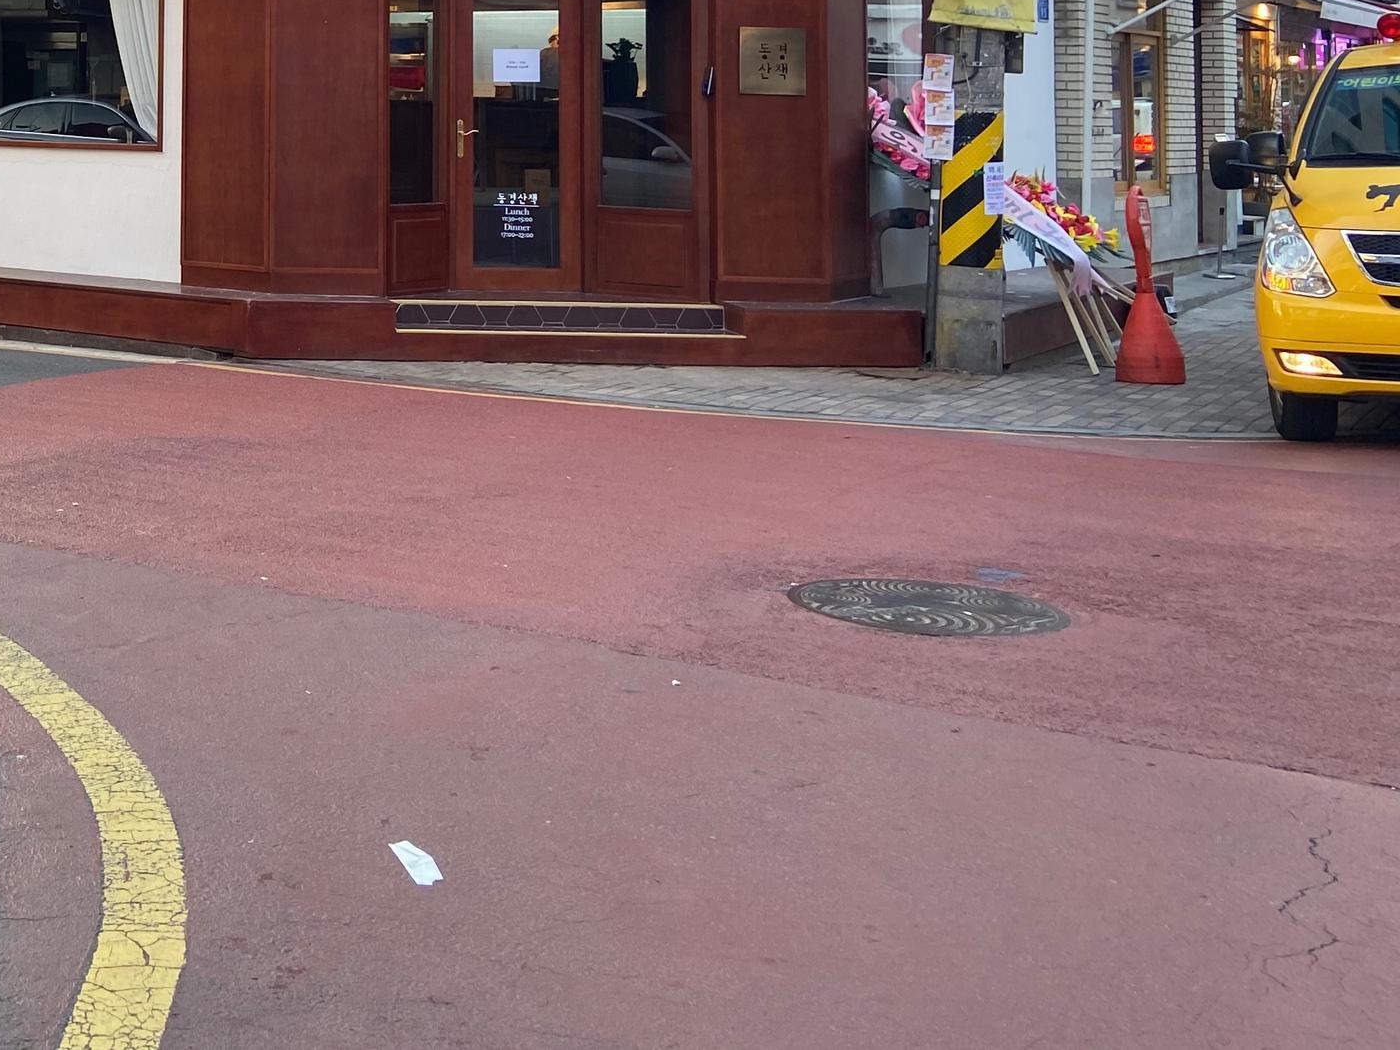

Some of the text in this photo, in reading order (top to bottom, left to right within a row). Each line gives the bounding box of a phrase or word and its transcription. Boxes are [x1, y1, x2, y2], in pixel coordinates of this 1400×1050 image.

[758, 43, 788, 60] 동경
[758, 62, 788, 80] 산책
[496, 192, 538, 205] 동경산책
[505, 207, 530, 216] Lunch
[503, 223, 532, 231] Dinner
